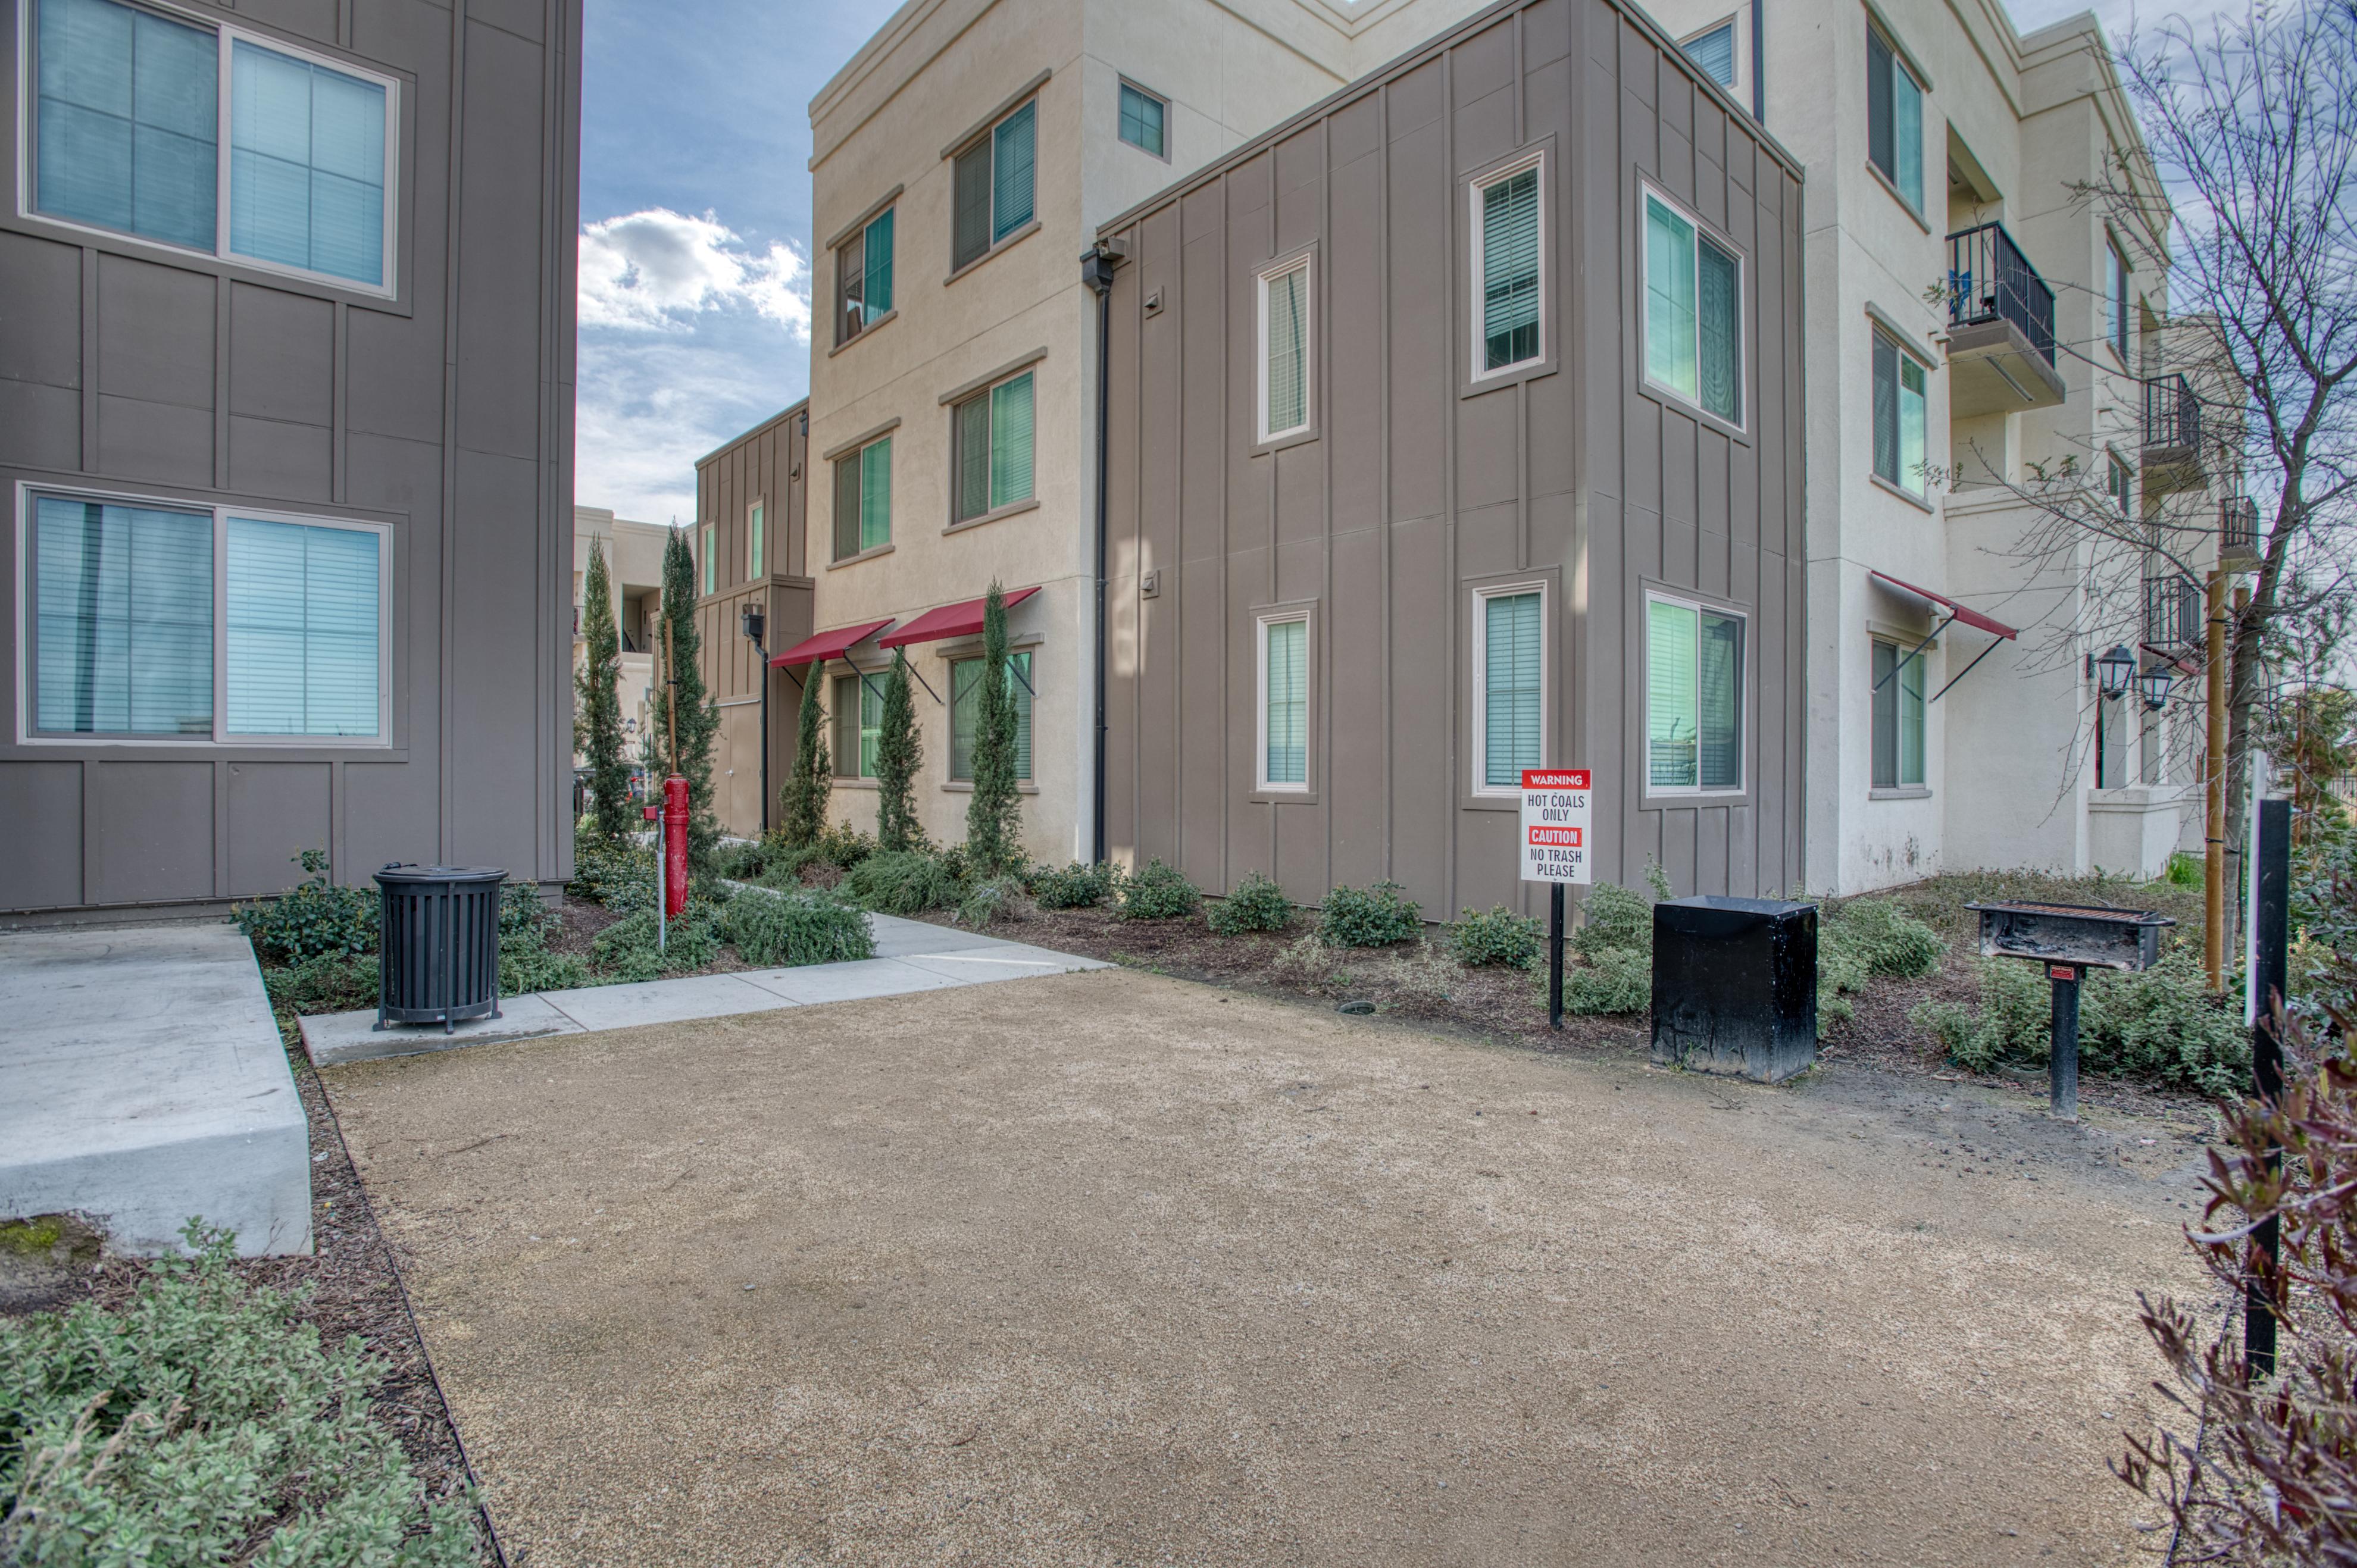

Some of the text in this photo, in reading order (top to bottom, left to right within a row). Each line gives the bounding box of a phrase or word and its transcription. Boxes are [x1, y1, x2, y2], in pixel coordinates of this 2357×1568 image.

[1531, 775, 1583, 785] WARNING
[1528, 795, 1584, 808] HOT COALS
[1543, 809, 1569, 821] ONLY
[1531, 830, 1577, 844] CAUTION
[1531, 849, 1581, 863] NO TRASH
[1537, 863, 1574, 877] PLEASE
